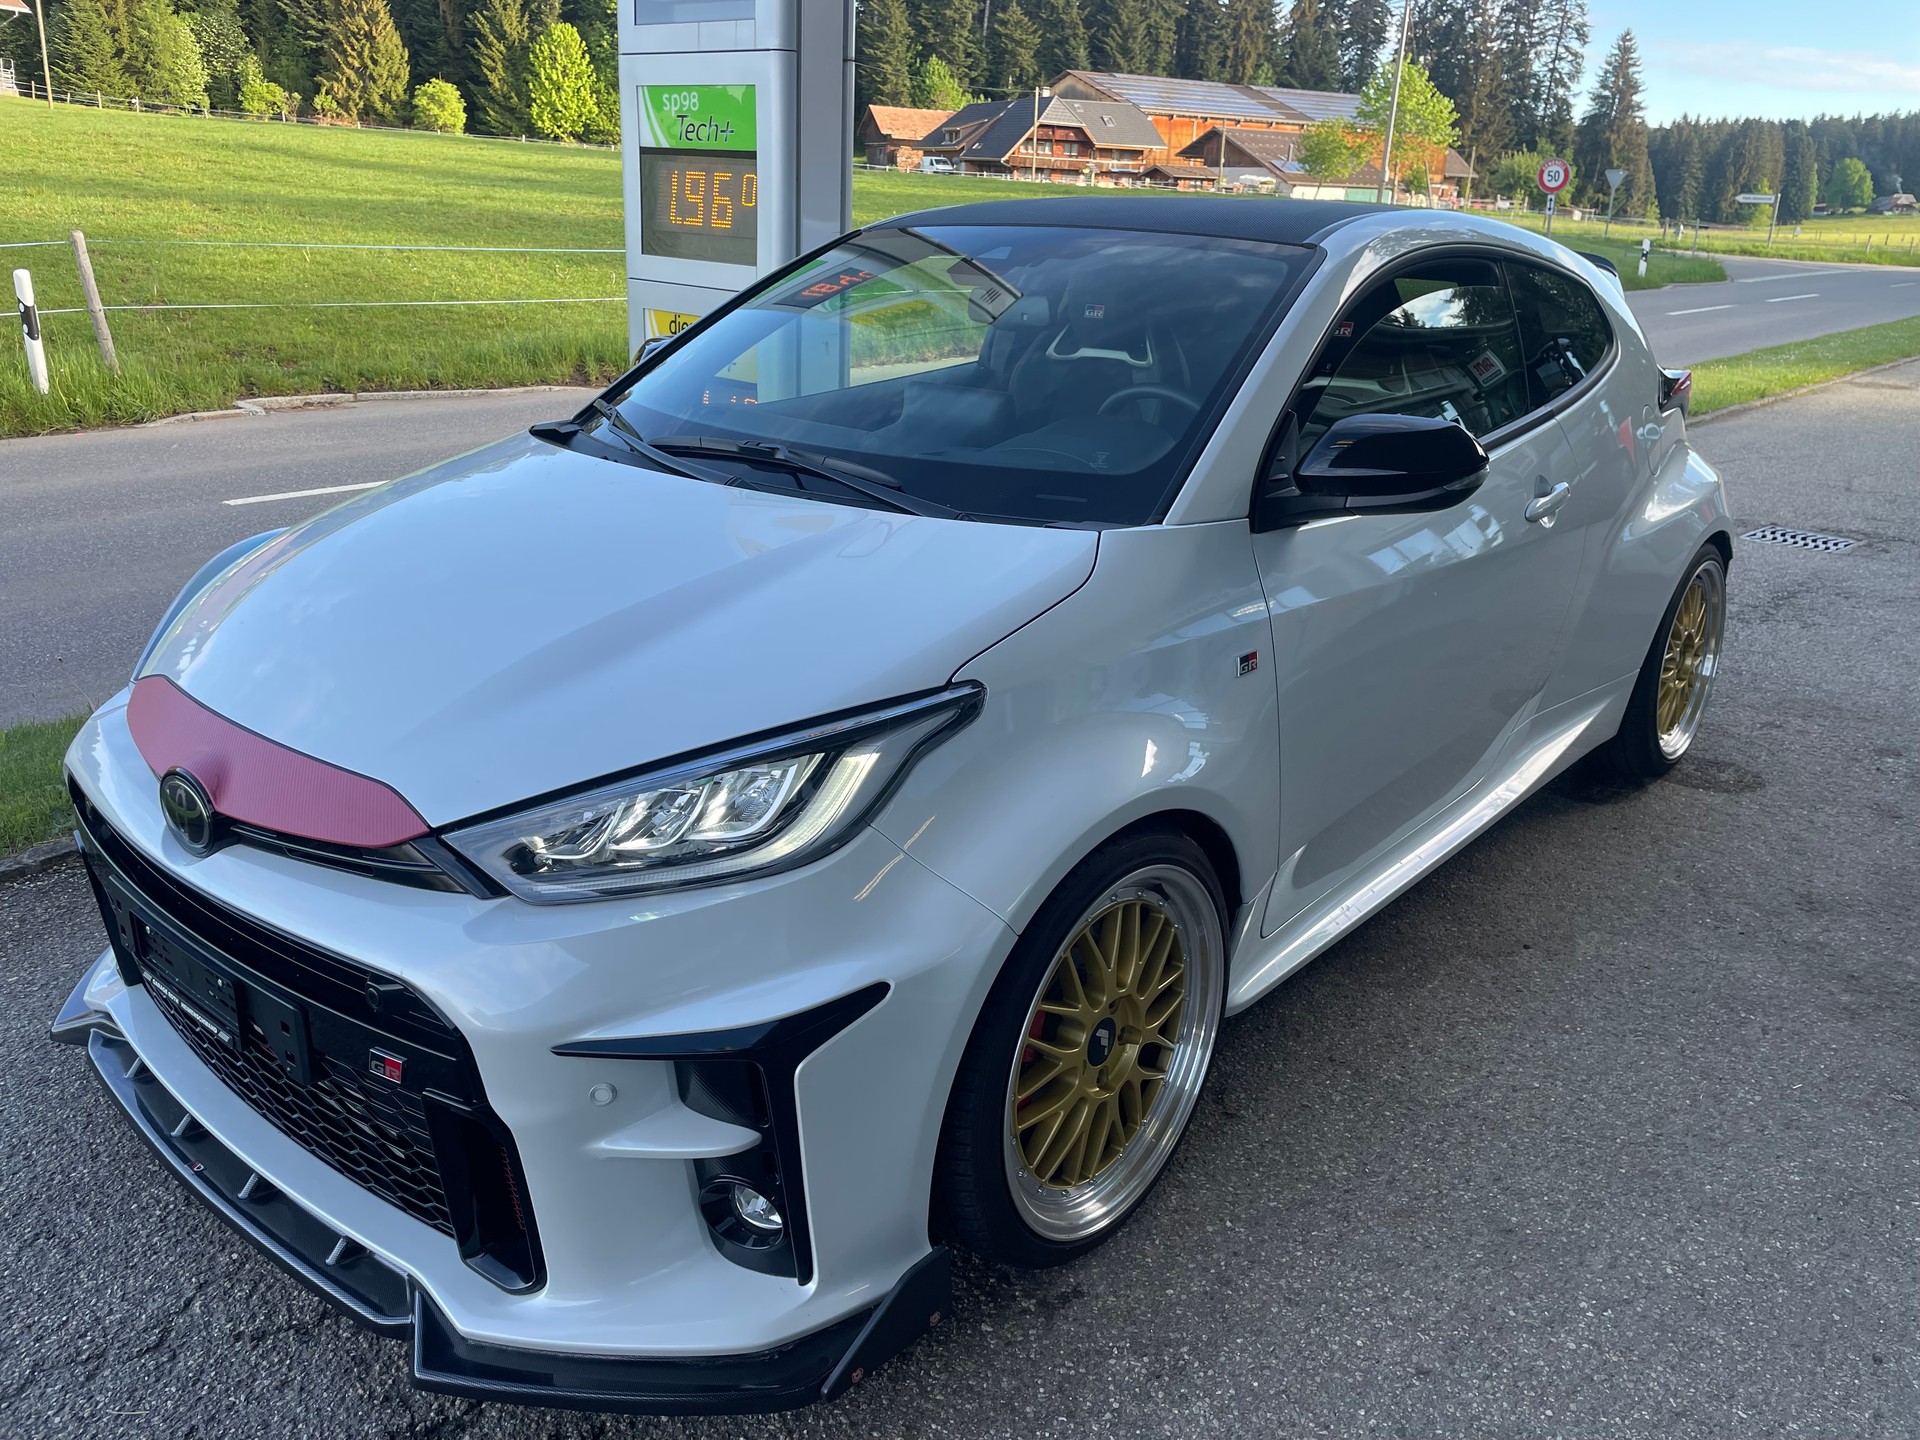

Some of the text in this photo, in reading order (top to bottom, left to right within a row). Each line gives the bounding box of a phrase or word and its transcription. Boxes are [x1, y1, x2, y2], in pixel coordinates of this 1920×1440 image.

[662, 91, 699, 117] sp98
[676, 114, 735, 143] Tech+
[1546, 169, 1561, 183] 50
[668, 313, 693, 335] die
[1240, 657, 1257, 675] GR
[370, 1058, 401, 1082] GR
